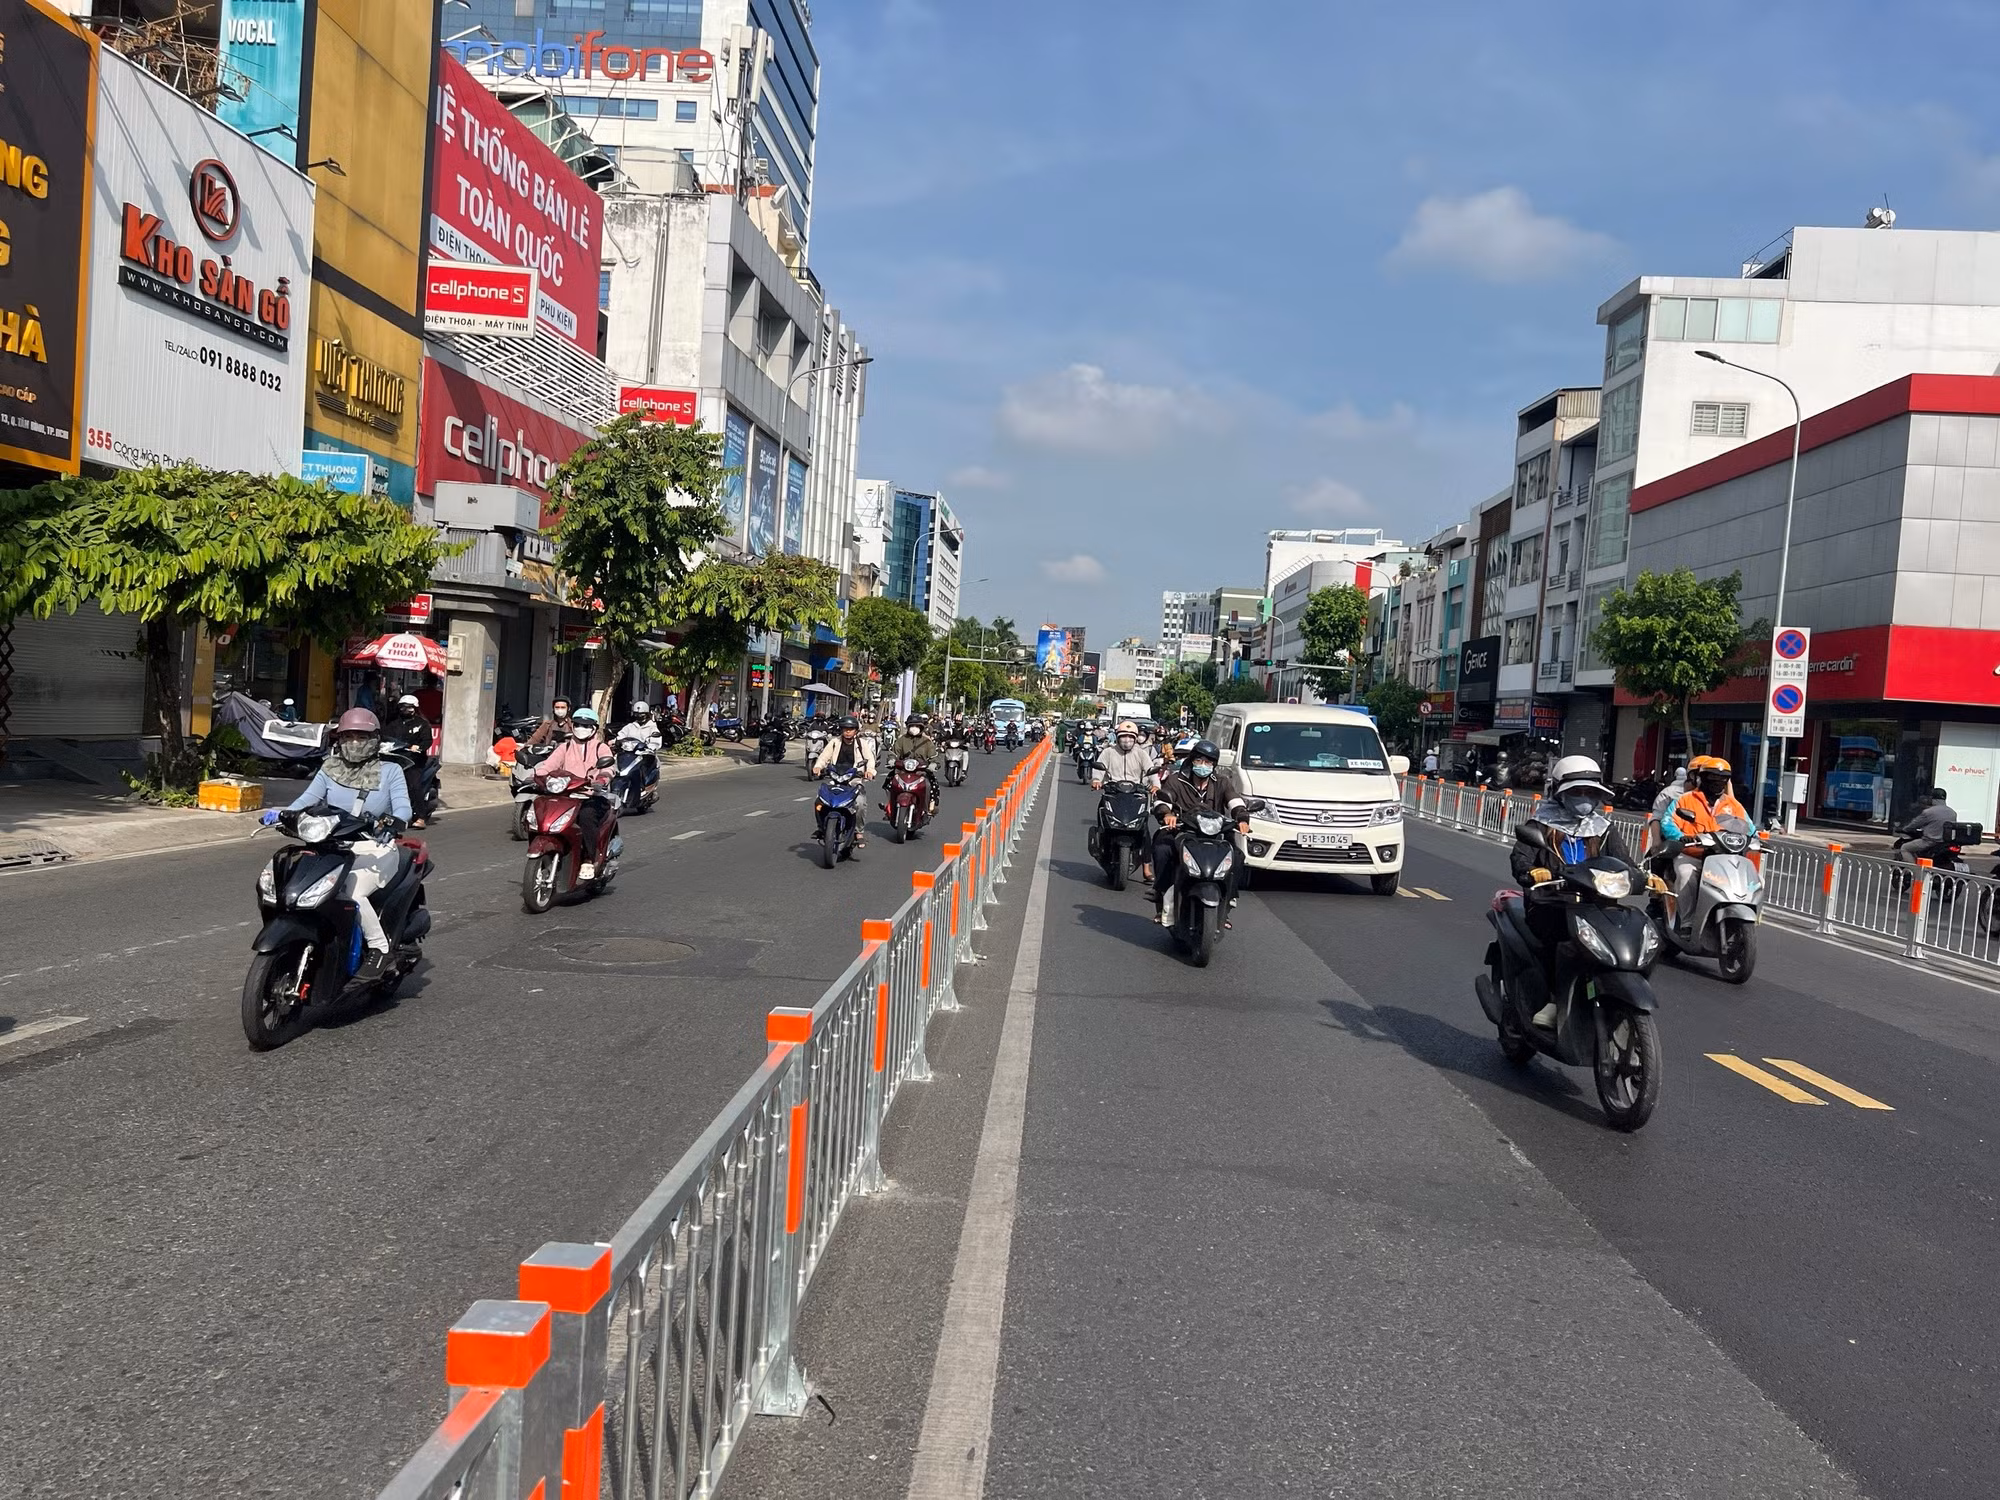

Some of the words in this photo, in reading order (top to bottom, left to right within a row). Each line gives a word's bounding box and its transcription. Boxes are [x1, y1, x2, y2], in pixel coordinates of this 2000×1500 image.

[227, 18, 276, 44] VOCAL
[444, 28, 712, 83] mobifone
[460, 107, 529, 200] THỐNG
[533, 172, 568, 233] BÁN
[571, 204, 590, 250] LẺ
[437, 226, 462, 256] ĐIỆN
[463, 242, 491, 264] THO
[456, 173, 511, 250] TOÀN
[515, 223, 564, 287] QUỐC
[121, 202, 193, 284] KHO
[199, 255, 254, 315] SÀN
[258, 276, 291, 330] GỖ
[431, 279, 510, 301] cellphone
[512, 287, 526, 305] S
[126, 271, 285, 348] WWW.KHOSANGO.COM
[425, 314, 446, 327] ĐIỆN
[448, 316, 476, 328] THOẠI
[485, 318, 504, 331] MÁY
[507, 320, 529, 332] TÍNH
[540, 298, 556, 319] PHỤ
[556, 307, 573, 331] KIỆN
[200, 346, 222, 370] 091
[226, 356, 257, 383] 8888
[260, 369, 282, 393] 032
[622, 397, 680, 412] cellphone
[683, 401, 693, 414] S
[88, 428, 113, 451] 355
[113, 440, 139, 461] Cộng
[443, 411, 557, 490] cellpho
[315, 464, 358, 475] THUONG
[1464, 649, 1488, 675] GENCE
[1826, 656, 1854, 672] cardin
[1302, 834, 1348, 844] 51E-310.45
